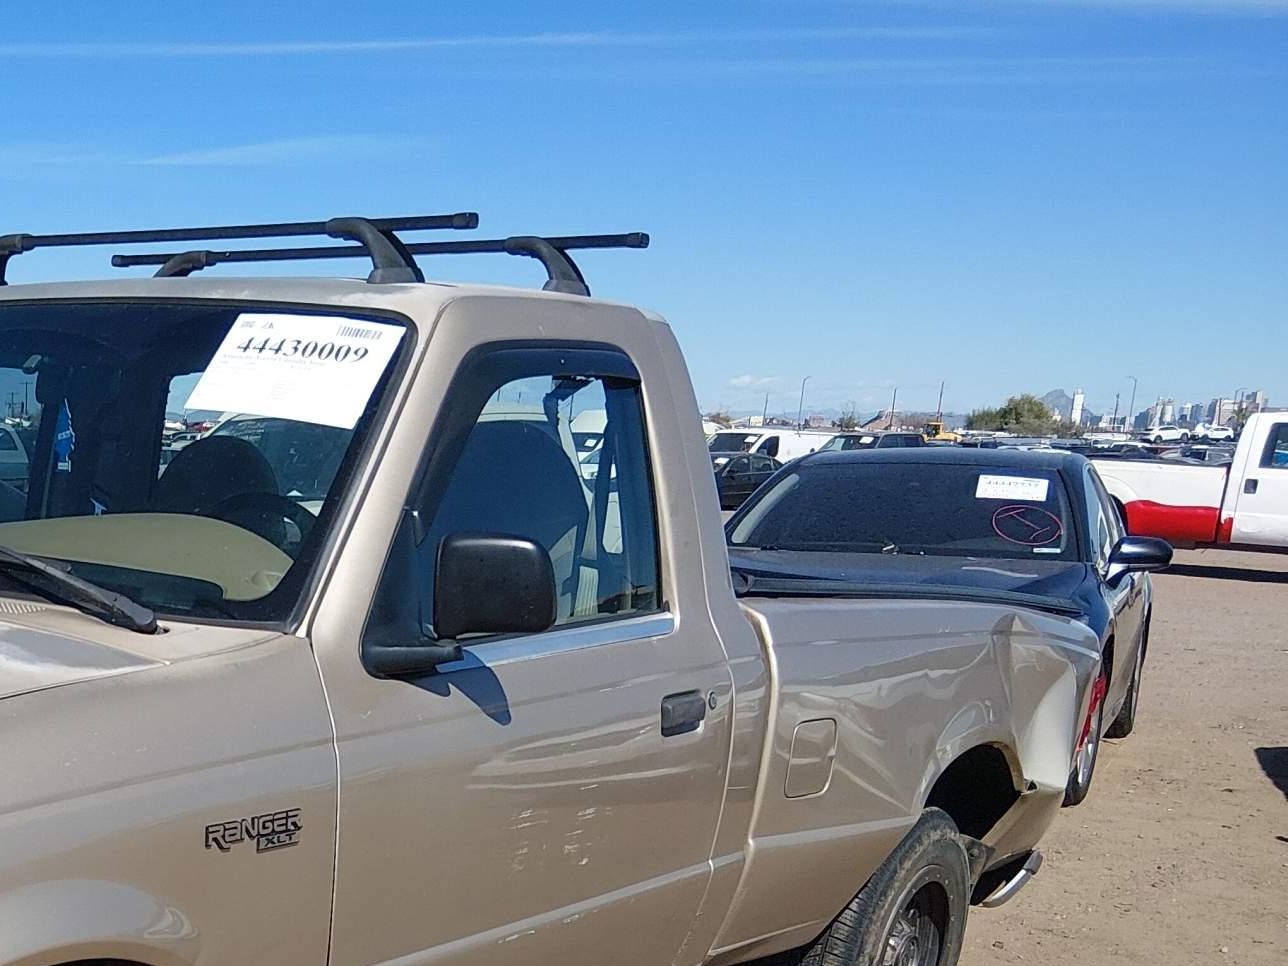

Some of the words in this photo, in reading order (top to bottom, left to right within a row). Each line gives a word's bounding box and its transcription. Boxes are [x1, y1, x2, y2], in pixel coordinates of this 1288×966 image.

[237, 336, 369, 363] 44430009
[205, 808, 304, 852] RANGER
[263, 832, 297, 848] XLT
